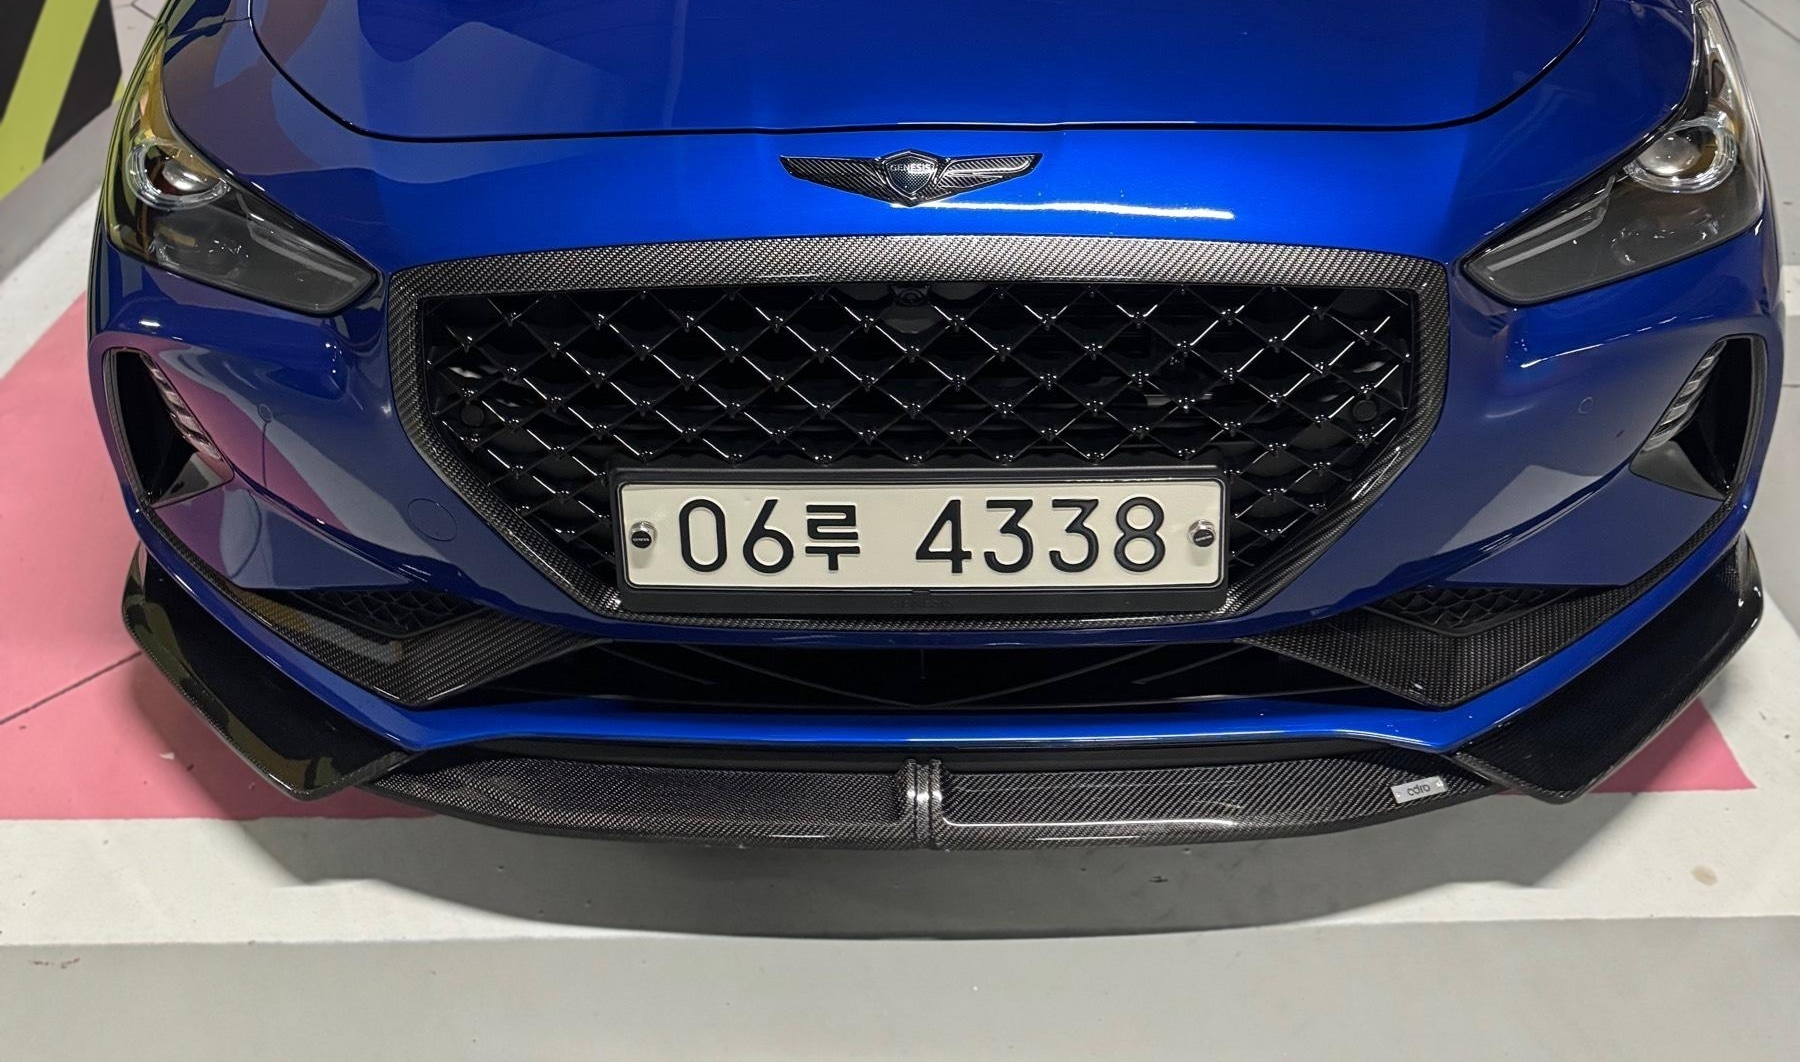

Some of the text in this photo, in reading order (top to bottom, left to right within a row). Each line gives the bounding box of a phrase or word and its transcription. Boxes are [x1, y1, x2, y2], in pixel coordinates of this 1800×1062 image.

[890, 163, 931, 171] GENESIS
[679, 496, 1166, 573] 06루 4338
